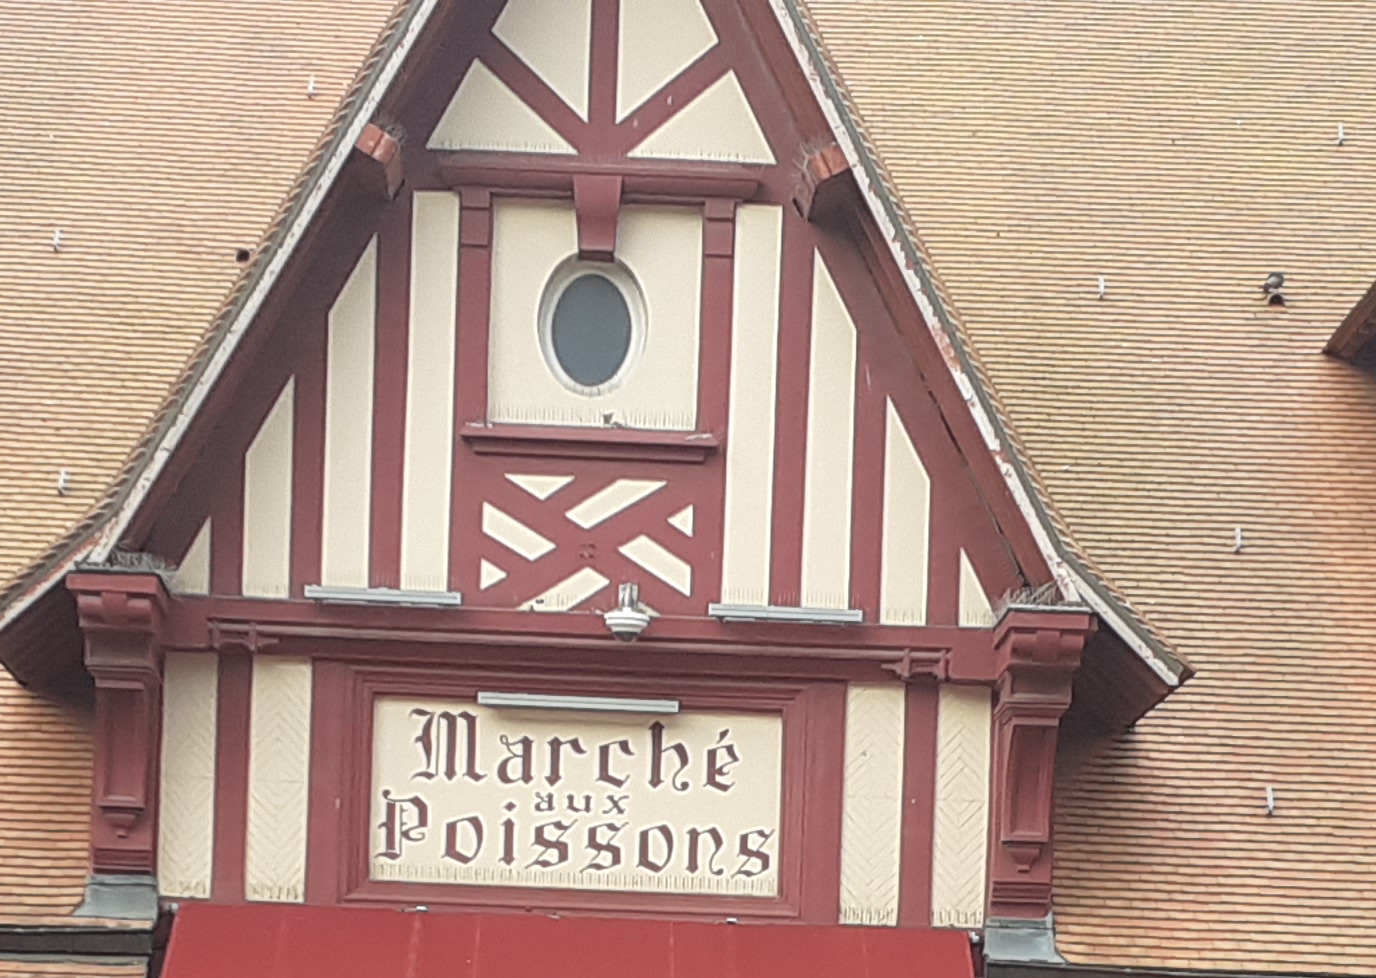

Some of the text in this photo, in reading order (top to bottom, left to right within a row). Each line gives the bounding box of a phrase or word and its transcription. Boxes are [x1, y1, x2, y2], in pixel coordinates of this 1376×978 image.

[409, 707, 740, 792] Marché
[375, 789, 776, 879] Poissons
[533, 791, 630, 815] aux
